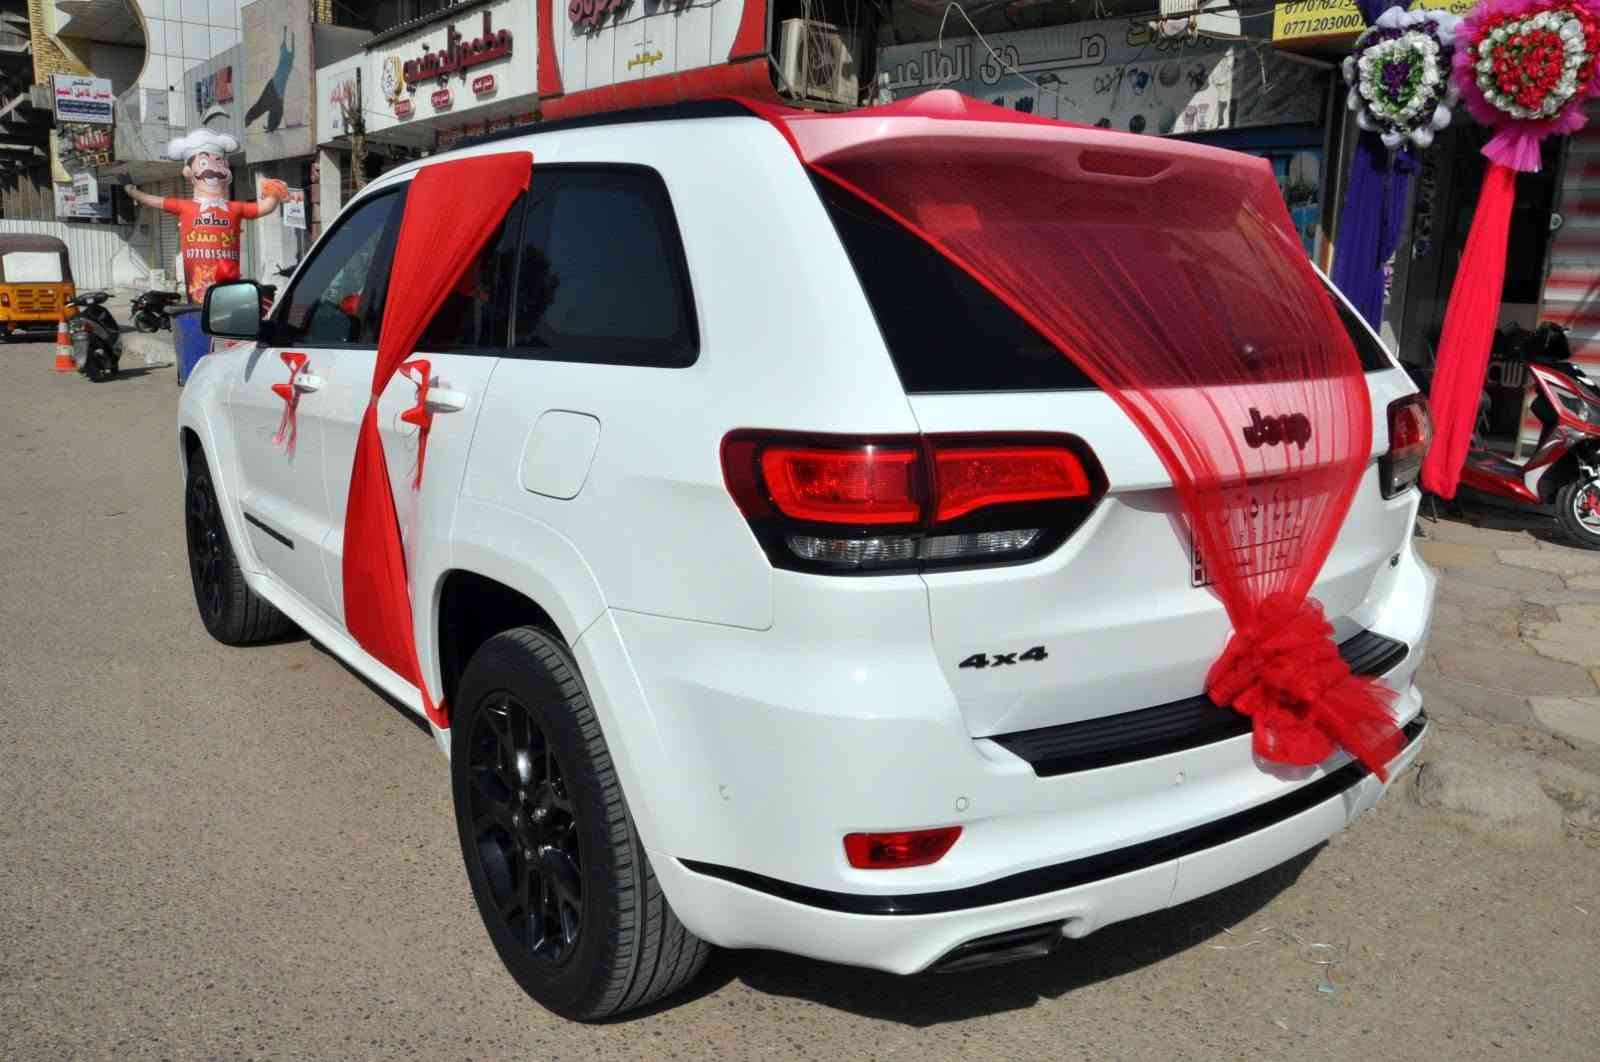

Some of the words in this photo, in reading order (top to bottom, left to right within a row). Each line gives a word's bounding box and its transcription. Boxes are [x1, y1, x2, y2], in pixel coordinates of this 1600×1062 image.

[979, 33, 1107, 86] صدى
[192, 213, 230, 226] مطعم
[1243, 407, 1312, 450] Jeep
[958, 645, 1049, 669] 4x4
